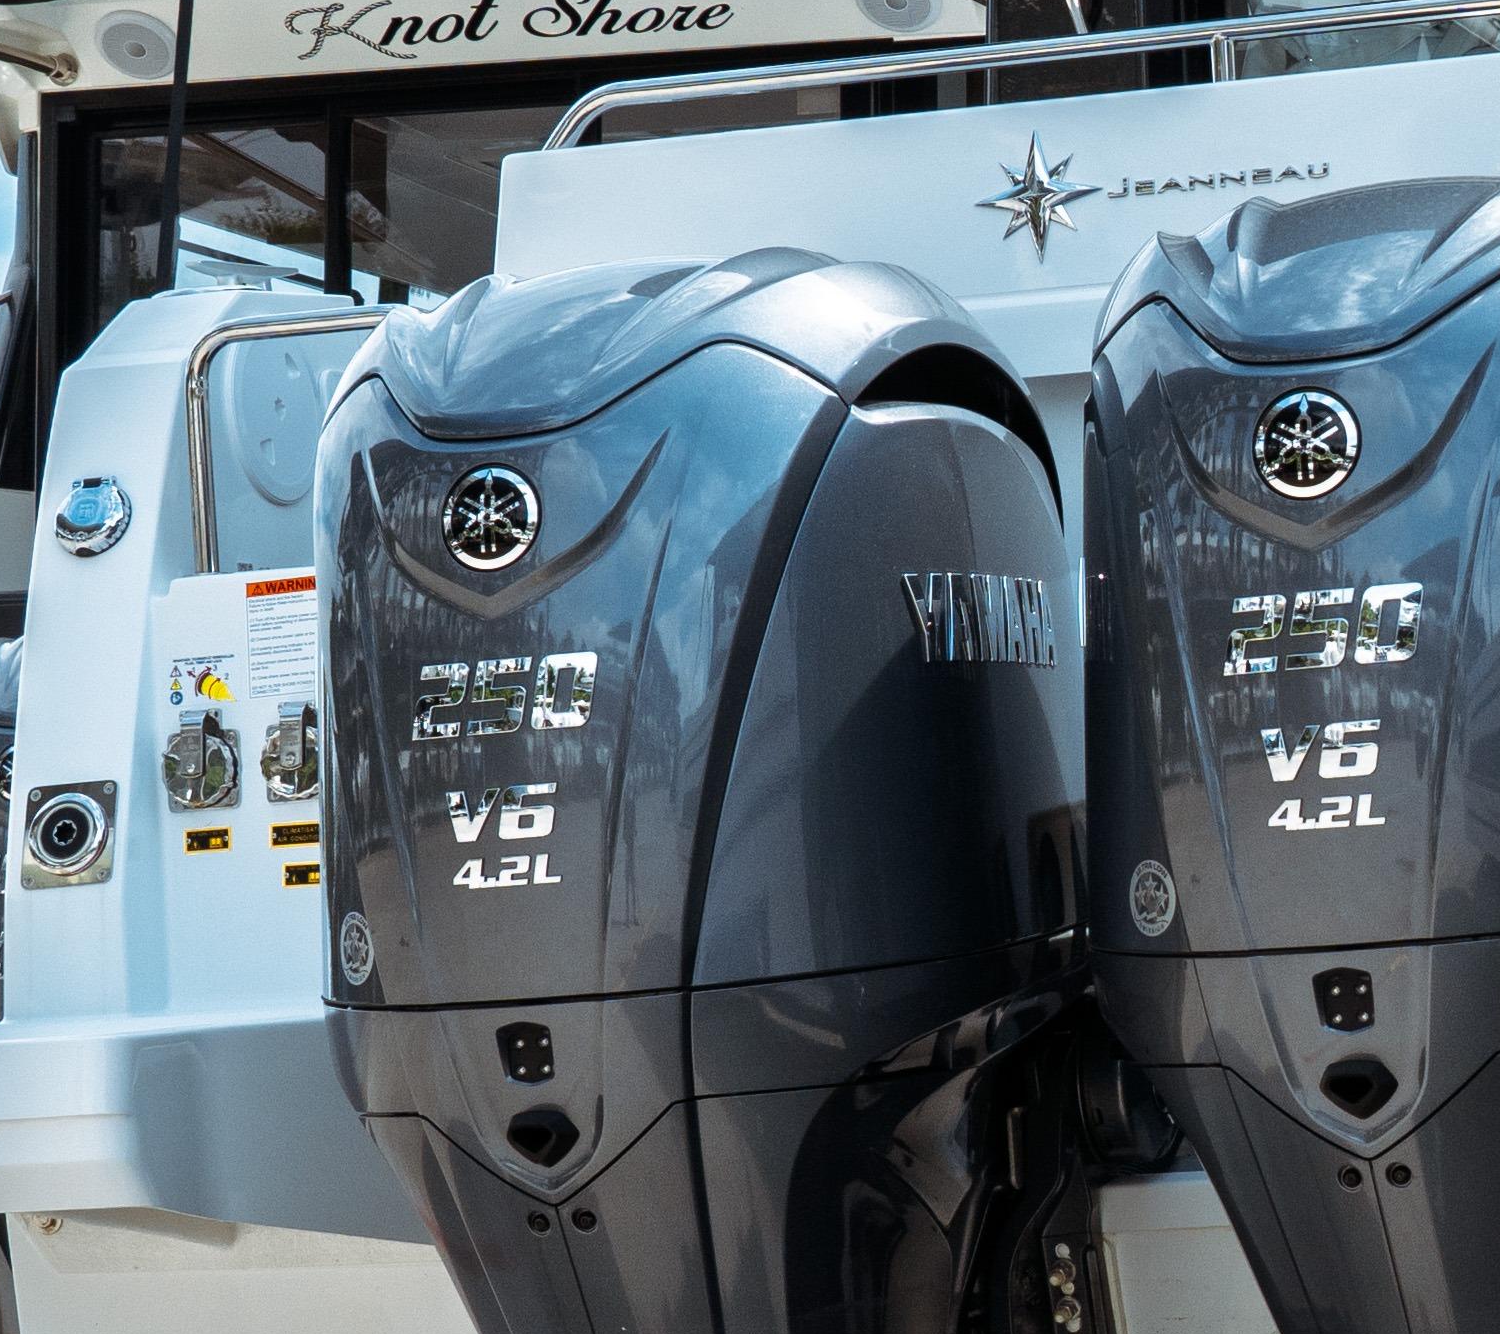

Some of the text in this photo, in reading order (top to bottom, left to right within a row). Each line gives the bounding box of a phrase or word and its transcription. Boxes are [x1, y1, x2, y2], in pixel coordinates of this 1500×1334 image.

[1107, 161, 1330, 199] JEANNEAU
[265, 576, 316, 594] WARNIN
[901, 571, 1057, 668] YAMAHA
[1223, 582, 1423, 677] 250
[411, 651, 598, 742] 250
[1260, 718, 1381, 782] V6
[445, 782, 558, 843] V6
[1267, 793, 1386, 831] 4.2L
[453, 853, 562, 890] 4.2L
